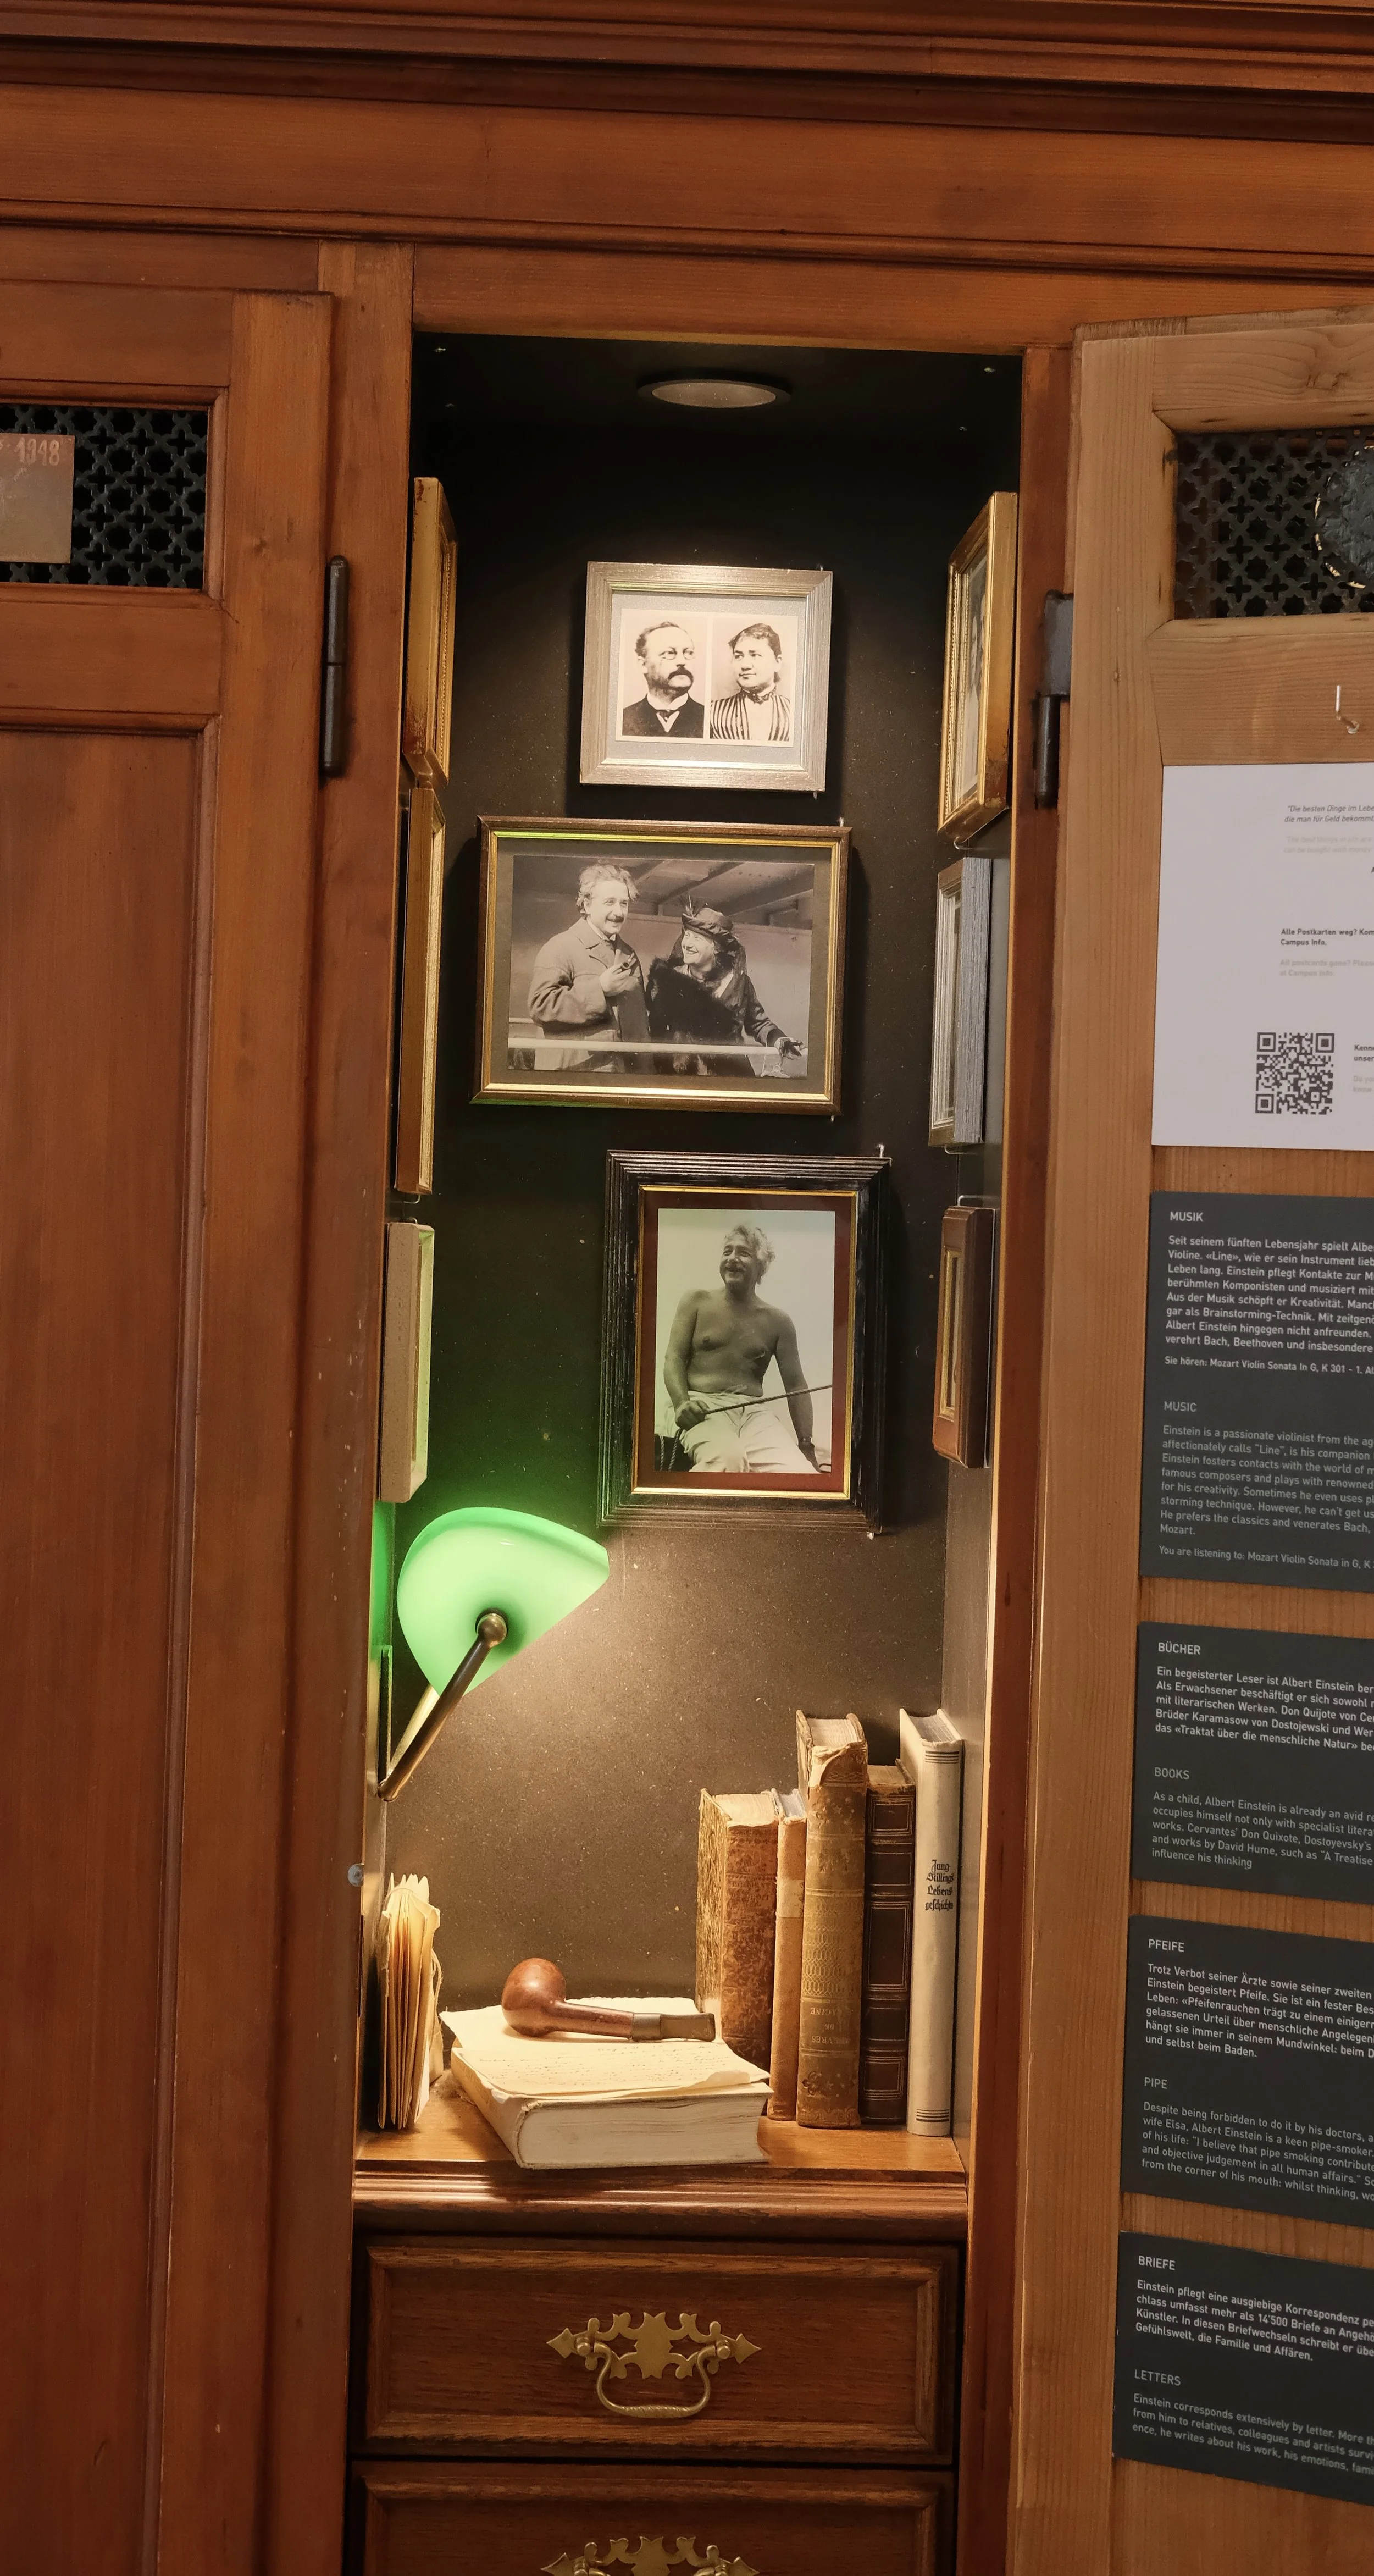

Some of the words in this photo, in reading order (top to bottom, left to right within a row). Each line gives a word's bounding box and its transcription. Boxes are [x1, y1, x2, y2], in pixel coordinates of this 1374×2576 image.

[14, 437, 59, 466] 1948
[1326, 804, 1346, 813] Dinge
[1312, 814, 1323, 822] für
[1338, 928, 1357, 937] weg?
[1280, 938, 1309, 947] Campus
[1170, 1210, 1203, 1222] MUSIK
[1168, 1235, 1187, 1245] Seit
[1189, 1236, 1224, 1246] seinem
[1227, 1237, 1261, 1247] fünften
[1265, 1239, 1319, 1251] Lebensjahr
[1321, 1241, 1348, 1252] spielt
[1167, 1277, 1219, 1289] berühmten
[1222, 1279, 1285, 1292] Komponisten
[1288, 1283, 1306, 1292] und
[1309, 1284, 1355, 1294] musiziert
[1165, 1319, 1195, 1330] Albert
[1199, 1320, 1237, 1332] Einstein
[1239, 1323, 1283, 1336] hingegen
[1287, 1325, 1310, 1335] nicht
[1313, 1326, 1371, 1338] anfreunden.
[1165, 1335, 1200, 1345] verehrt
[1204, 1335, 1230, 1347] Bach,
[1233, 1336, 1283, 1348] Beethoven
[1286, 1340, 1305, 1350] und
[1307, 1340, 1373, 1353] insbesondere
[1164, 1400, 1197, 1412] MUSIC
[1162, 1424, 1200, 1436] Einstein
[1203, 1427, 1212, 1436] is
[1222, 1429, 1274, 1440] passionate
[1276, 1431, 1314, 1442] violinist
[1317, 1433, 1340, 1444] from
[1343, 1435, 1359, 1445] the
[1160, 1509, 1173, 1519] He
[1176, 1511, 1211, 1522] prefers
[1213, 1513, 1228, 1523] the
[1231, 1514, 1270, 1525] classics
[1272, 1517, 1290, 1527] and
[1293, 1520, 1340, 1530] venerates
[1343, 1521, 1370, 1534] Bach,
[1160, 1523, 1195, 1535] Mozart.
[1157, 1640, 1201, 1655] BÜCHER
[1157, 1665, 1171, 1676] Ein
[1174, 1667, 1233, 1681] begeisterter
[1236, 1672, 1264, 1684] Leser
[1267, 1674, 1278, 1685] ist
[1281, 1676, 1312, 1688] Albert
[1315, 1679, 1354, 1691] Einstein
[1155, 1707, 1189, 1720] Brüder
[1192, 1711, 1249, 1726] Karamasow
[1251, 1719, 1268, 1727] von
[1271, 1718, 1329, 1733] Dostojewski
[1332, 1725, 1350, 1735] und
[1154, 1766, 1189, 1780] BOOKS
[1152, 1821, 1184, 1831] works.
[1241, 1828, 1259, 1838] Don
[1262, 1830, 1300, 1844] Quixote,
[1151, 1834, 1169, 1844] and
[1171, 1837, 1201, 1847] works
[1204, 1838, 1215, 1850] by
[1218, 1839, 1244, 1851] David
[1246, 1843, 1277, 1856] Hume,
[1281, 1848, 1303, 1858] such
[1305, 1851, 1317, 1860] as
[1334, 1851, 1373, 1865] Treatise
[1151, 1847, 1194, 1861] influence
[1197, 1852, 1211, 1862] his
[1214, 1854, 1252, 1870] thinking
[927, 1884, 953, 1896] Lebens
[1148, 1938, 1184, 1953] PFEIFE
[1147, 1963, 1171, 1975] Trotz
[1174, 1965, 1205, 1979] Verbot
[1208, 1971, 1238, 1983] seiner
[1240, 1972, 1267, 1986] Ärzte
[1270, 1980, 1298, 1990] sowie
[1300, 1983, 1331, 1994] seiner
[1334, 1988, 1372, 1999] zweiten
[1145, 2035, 1162, 2045] und
[1166, 2037, 1194, 2049] selbst
[1198, 2040, 1221, 2052] beim
[1224, 2043, 1257, 2057] Baden.
[1144, 2076, 1167, 2089] PIPE
[1142, 2116, 1162, 2127] wife
[1165, 2118, 1188, 2131] Elsa,
[1191, 2122, 1221, 2135] Albert
[1225, 2126, 1262, 2141] Einstein
[1265, 2132, 1273, 2142] is
[1285, 2135, 1307, 2147] keen
[1142, 2145, 1159, 2154] and
[1162, 2147, 1204, 2161] objective
[1206, 2152, 1256, 2169] judgement
[1259, 2160, 1268, 2170] in
[1271, 2163, 1283, 2173] all
[1286, 2164, 1319, 2177] human
[1138, 2254, 1176, 2270] BRIEFE
[1136, 2307, 1178, 2323] Künstler.
[1181, 2314, 1190, 2325] In
[1193, 2317, 1225, 2331] diesen
[1228, 2322, 1297, 2343] Briefwechseln
[1299, 2336, 1339, 2351] schreibt
[1342, 2344, 1354, 2353] er
[1135, 2321, 1194, 2341] Gefühlswelt,
[1197, 2332, 1212, 2343] die
[1215, 2334, 1250, 2350] Familie
[1253, 2343, 1271, 2353] und
[1273, 2345, 1313, 2361] Affären.
[1134, 2368, 1181, 2386] LETTERS
[1133, 2407, 1155, 2420] from
[1158, 2411, 1176, 2424] him
[1179, 2416, 1188, 2426] to
[1191, 2419, 1235, 2435] relatives,
[1238, 2428, 1289, 2444] colleagues
[1292, 2438, 1310, 2448] and
[1312, 2442, 1345, 2455] artists
